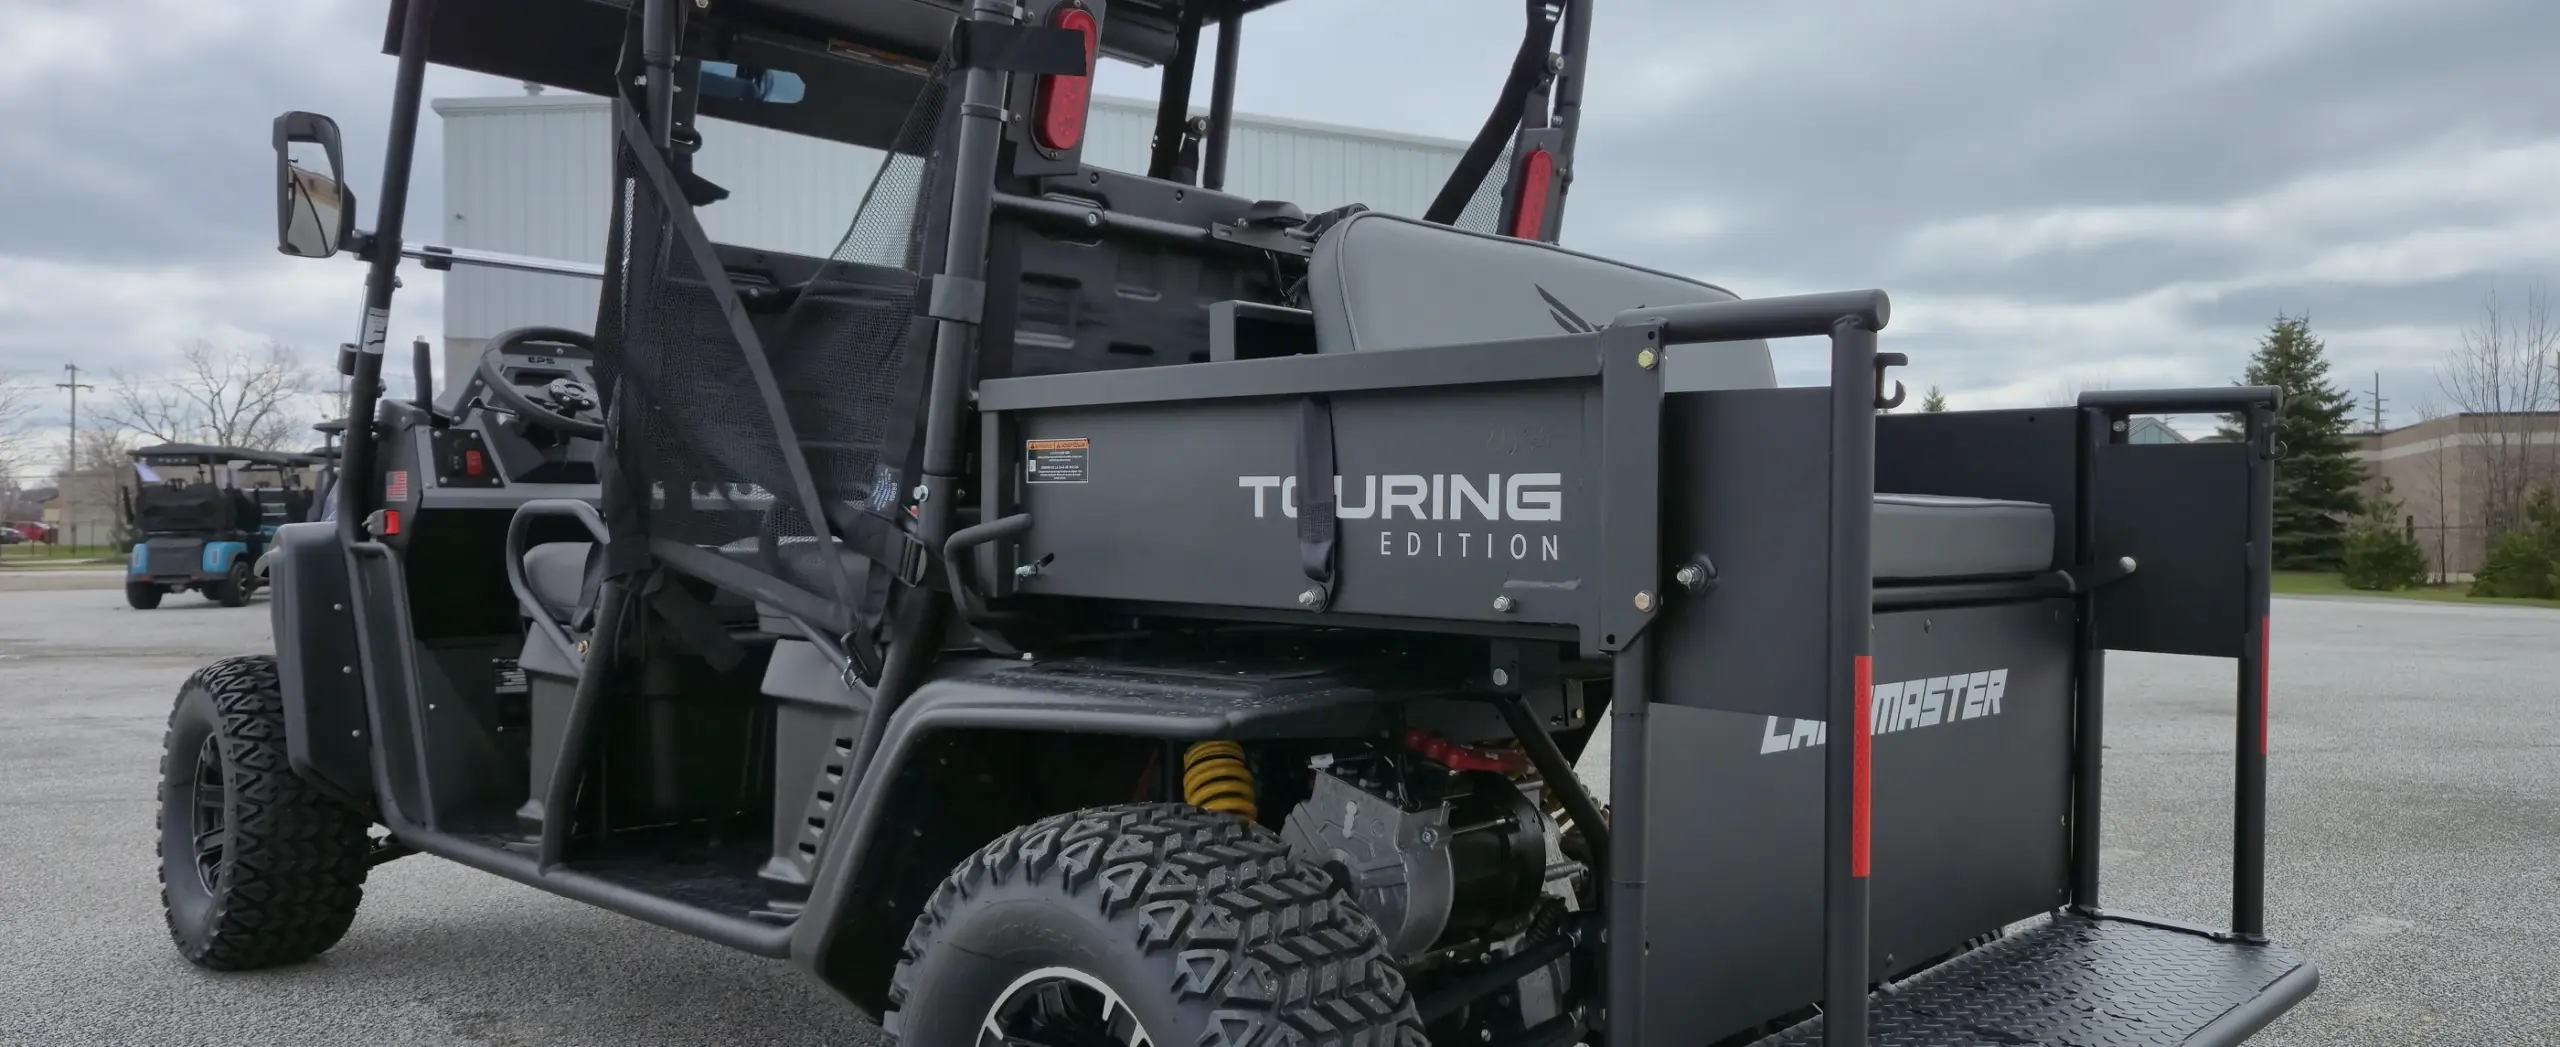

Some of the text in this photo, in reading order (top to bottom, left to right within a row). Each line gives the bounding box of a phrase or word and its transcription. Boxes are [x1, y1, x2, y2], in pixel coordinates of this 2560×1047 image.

[528, 356, 555, 364] EPS
[1380, 531, 1558, 561] EDITION
[1760, 668, 2008, 754] LAMASTER
